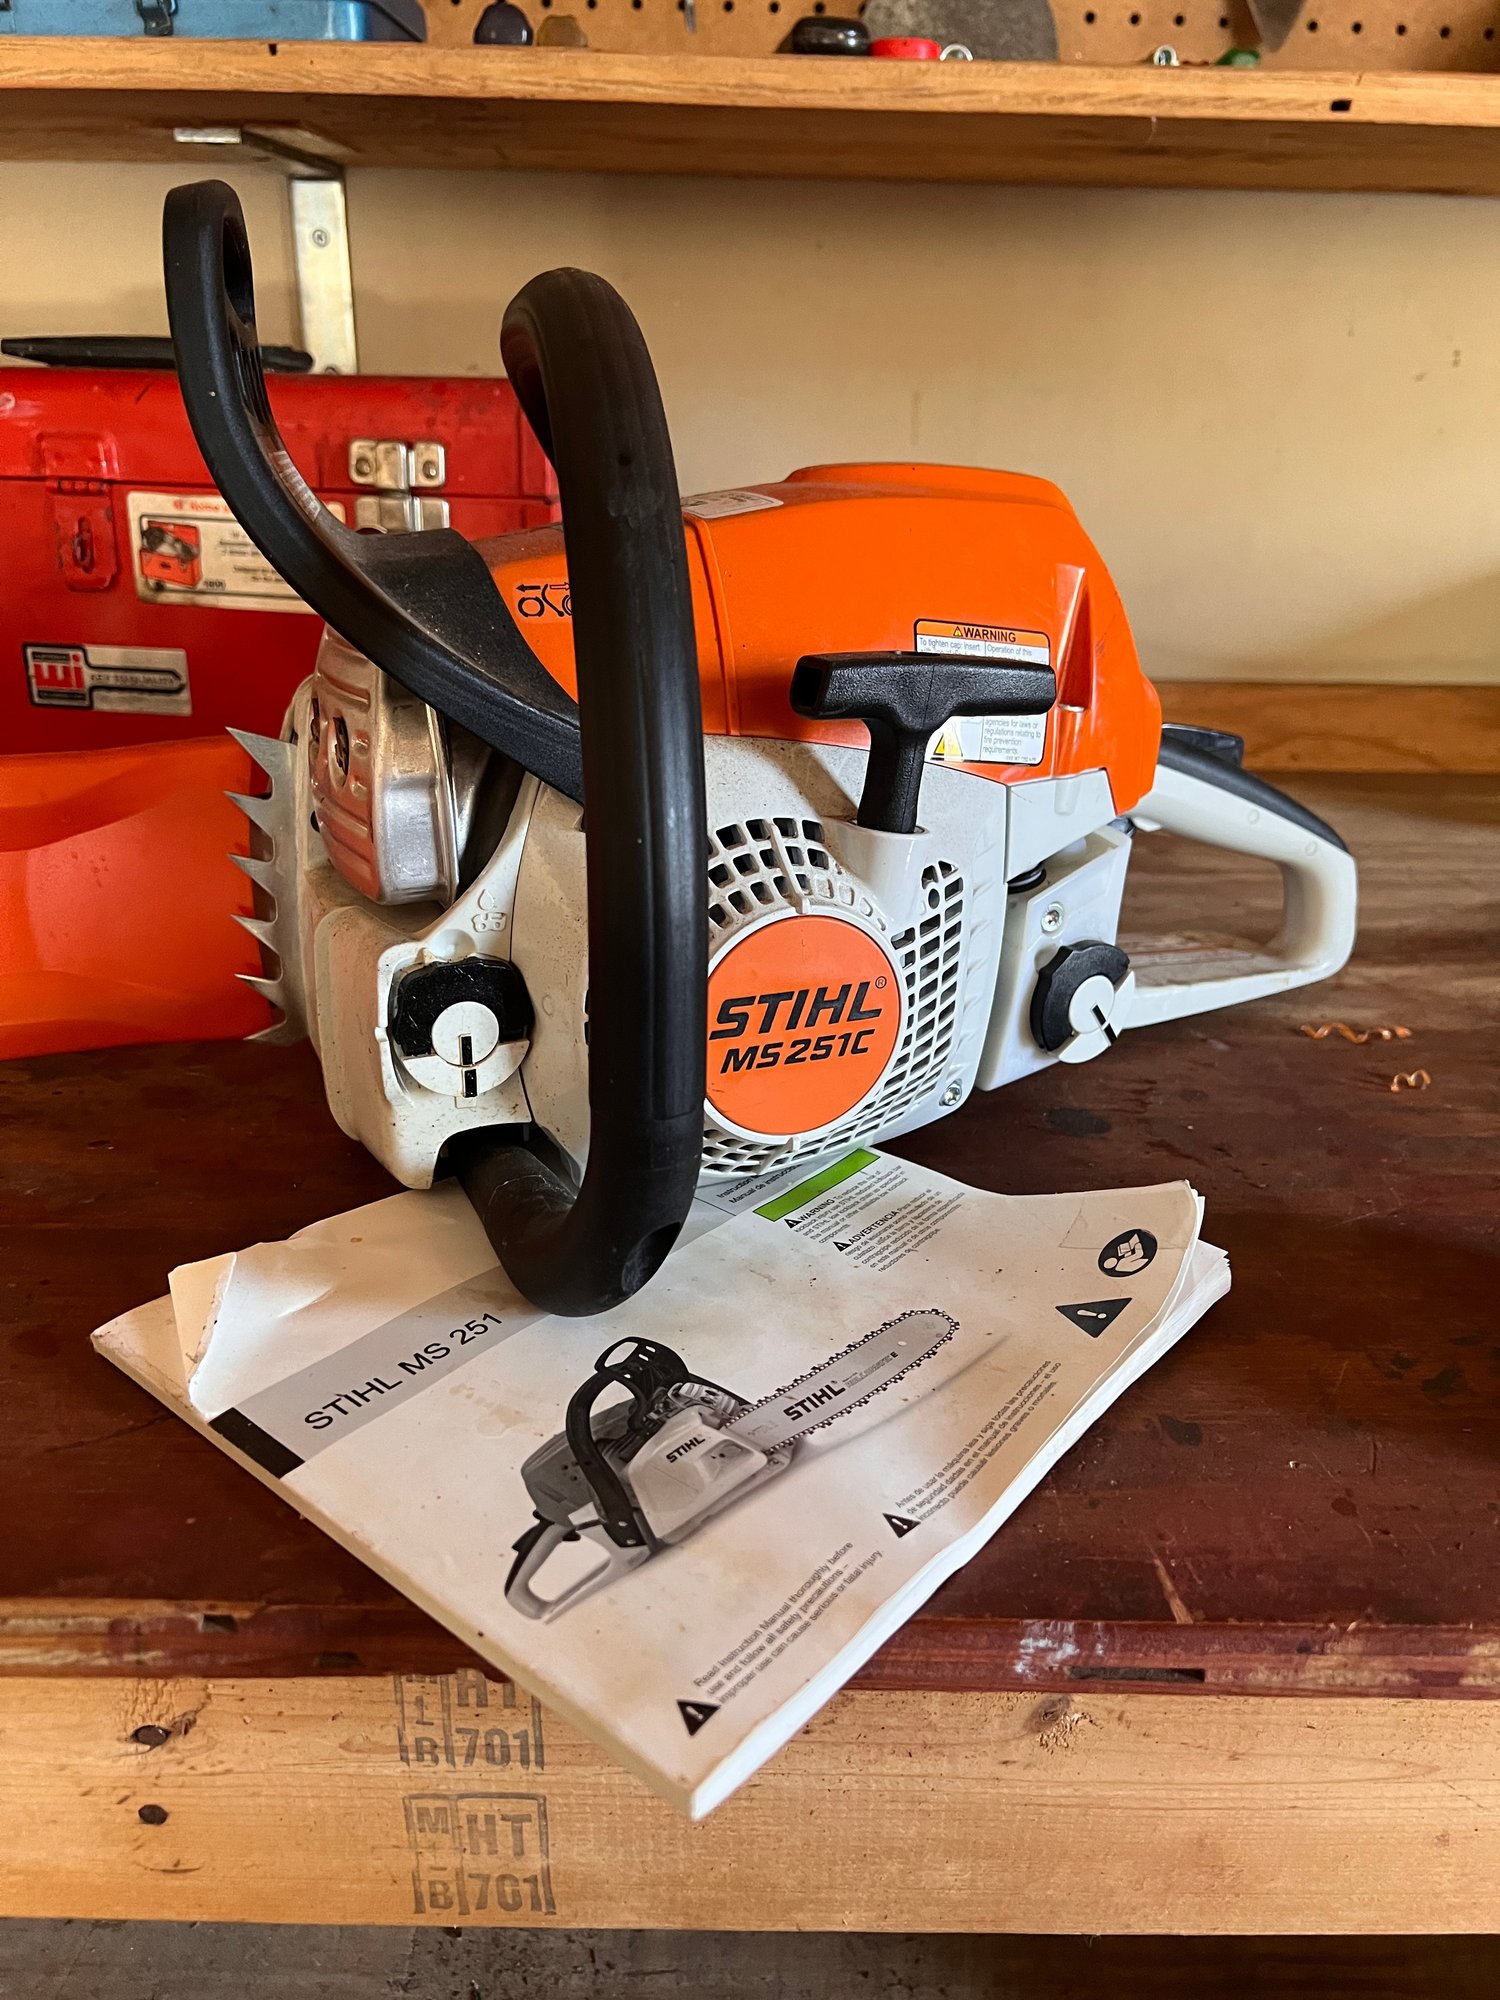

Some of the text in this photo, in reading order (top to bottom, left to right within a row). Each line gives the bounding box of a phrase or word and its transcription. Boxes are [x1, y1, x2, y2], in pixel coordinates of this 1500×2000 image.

[919, 637, 927, 646] To
[928, 638, 948, 650] tighten
[963, 626, 1016, 643] WARNING
[987, 643, 1014, 657] Operation
[1022, 647, 1032, 657] this
[984, 728, 1014, 737] regulations
[1010, 719, 1018, 727] for
[993, 738, 1022, 746] prevention
[709, 981, 882, 1041] STIHL
[716, 1178, 753, 1199] Instruction
[729, 1188, 756, 1203] Manual
[839, 1196, 856, 1206] STIHL
[799, 1199, 835, 1223] WARNING
[813, 1220, 830, 1230] STIHL
[849, 1209, 899, 1245] ADVERTENCIA
[304, 1312, 503, 1430] STIHL MS 251
[783, 1382, 846, 1421] STIHL
[666, 1435, 705, 1464] STIHL
[896, 1494, 916, 1508] Antes
[924, 1477, 937, 1488] usar
[917, 1483, 947, 1508] seguridad
[964, 1459, 974, 1467] en
[918, 1498, 950, 1521] incorrecto
[694, 1543, 853, 1687] Read Instruction Manual thoroughly before
[708, 1681, 724, 1694] use
[725, 1665, 742, 1680] and
[740, 1644, 765, 1666] follow
[766, 1633, 777, 1644] all
[777, 1612, 801, 1634] safety
[800, 1569, 843, 1613] precautions
[719, 1670, 756, 1704] improper
[756, 1657, 773, 1672] use
[772, 1642, 788, 1658] can
[788, 1620, 811, 1643] cause
[811, 1592, 838, 1620] serious
[837, 1584, 846, 1593] or
[455, 1728, 531, 1769] 701
[417, 1807, 532, 1857] M HT
[428, 1880, 454, 1910] B
